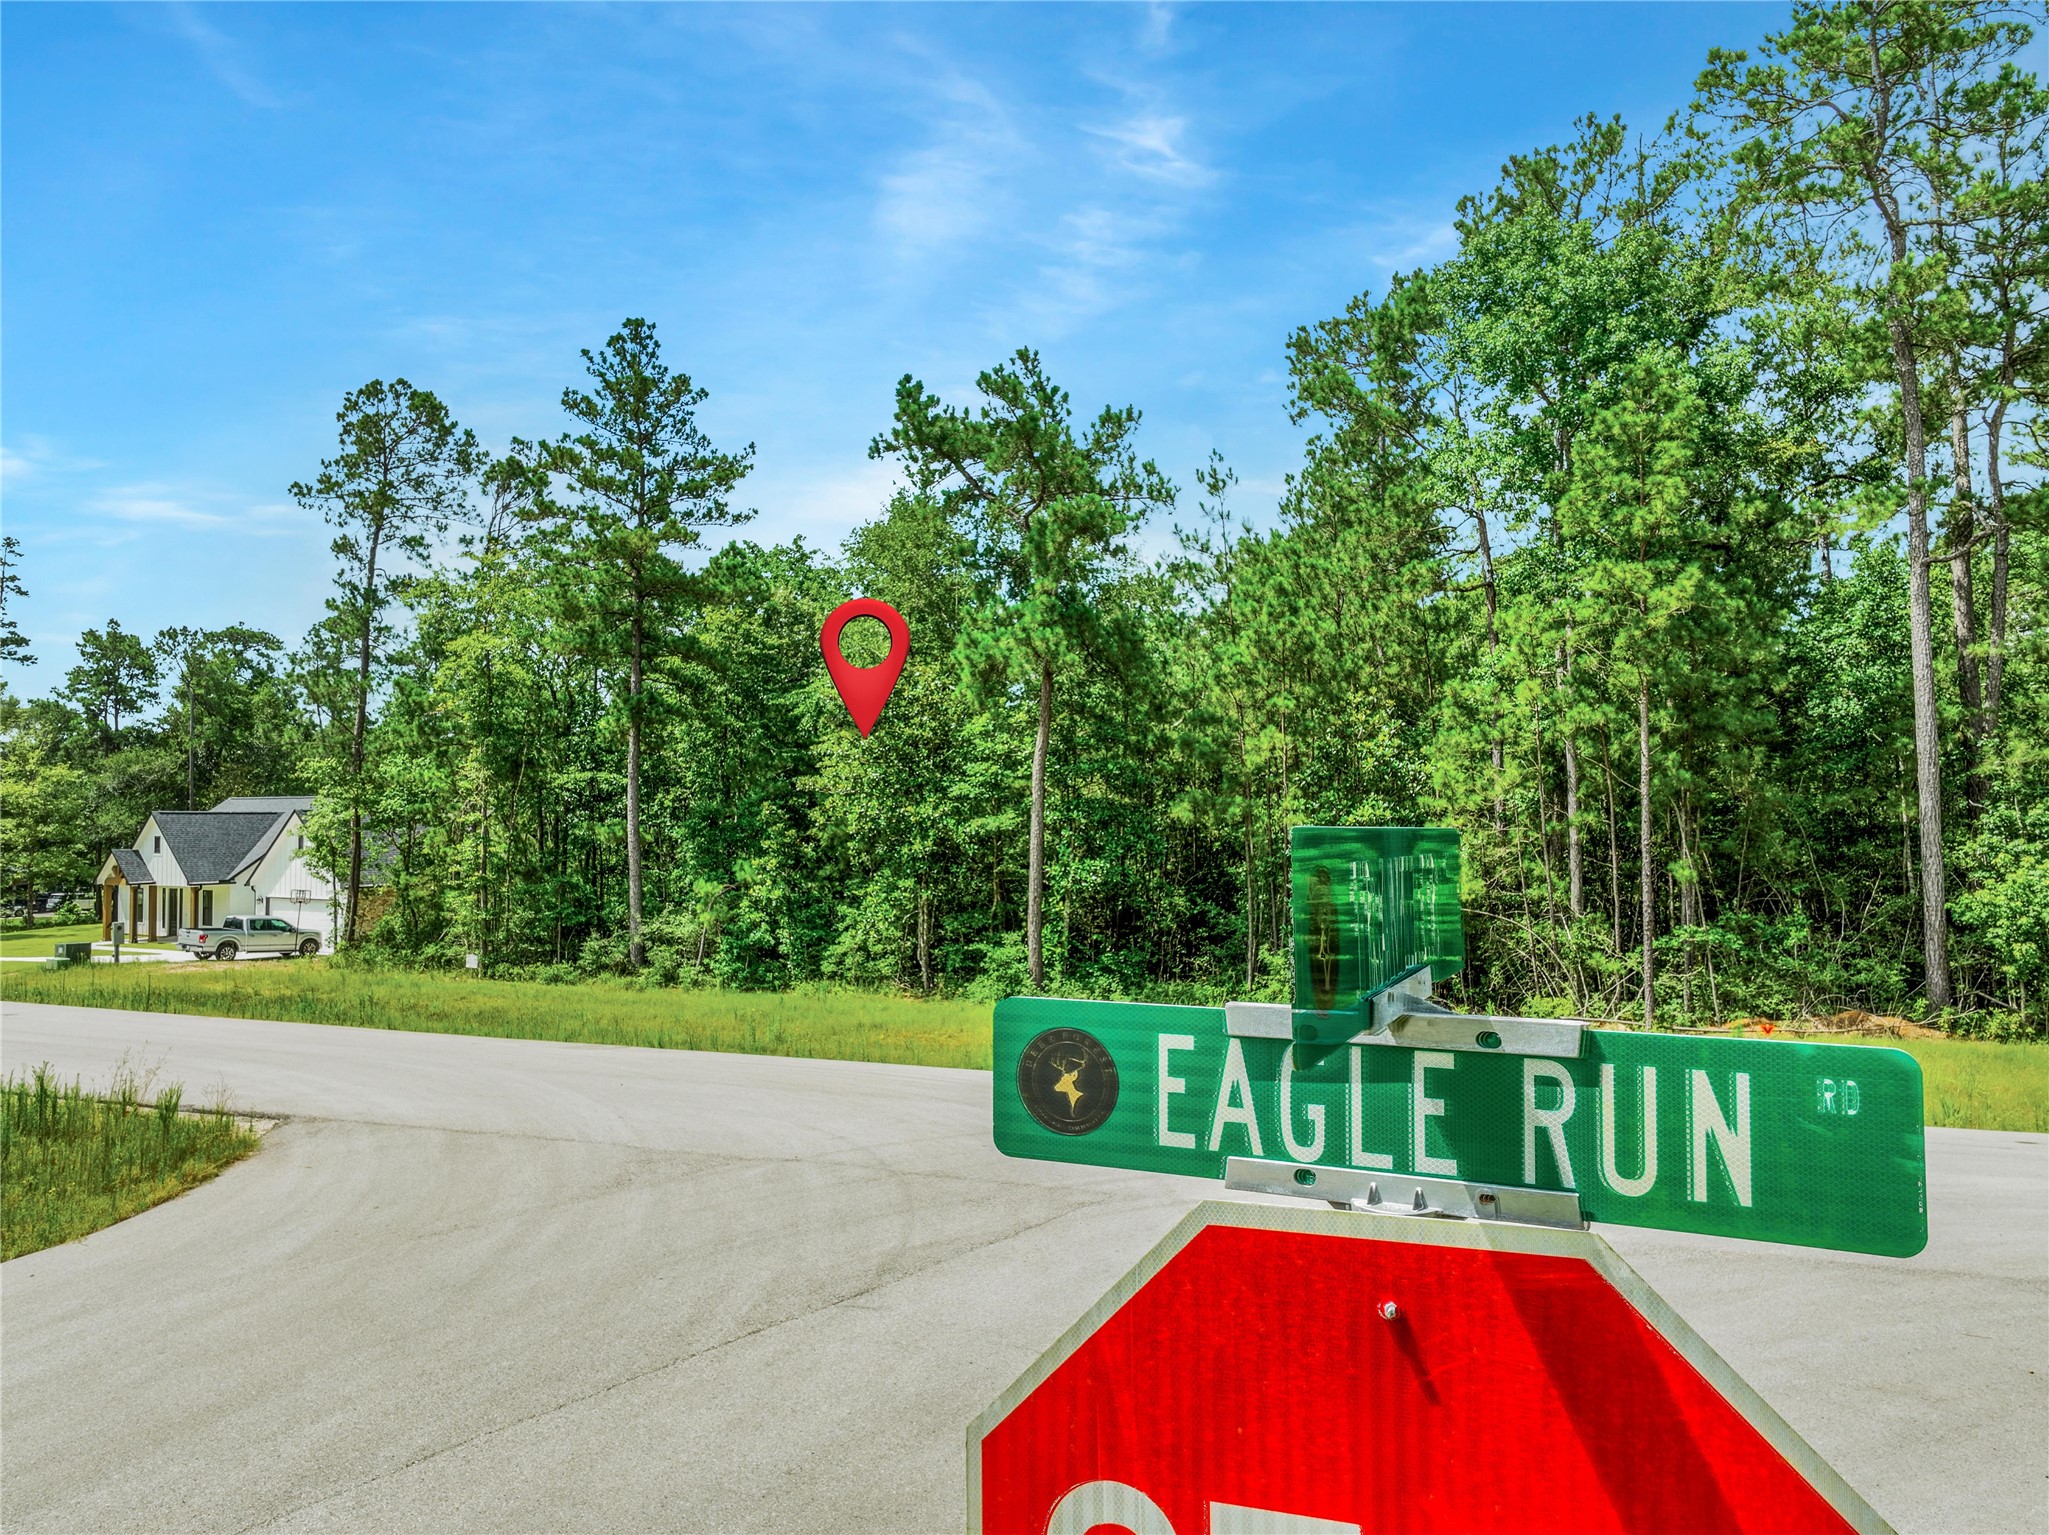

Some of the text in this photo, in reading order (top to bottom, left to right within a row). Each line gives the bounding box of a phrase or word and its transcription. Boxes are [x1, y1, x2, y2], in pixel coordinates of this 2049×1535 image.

[1156, 1033, 1457, 1176] EAGLE
[1523, 1058, 1752, 1207] RUN
[1818, 1078, 1860, 1115] RD
